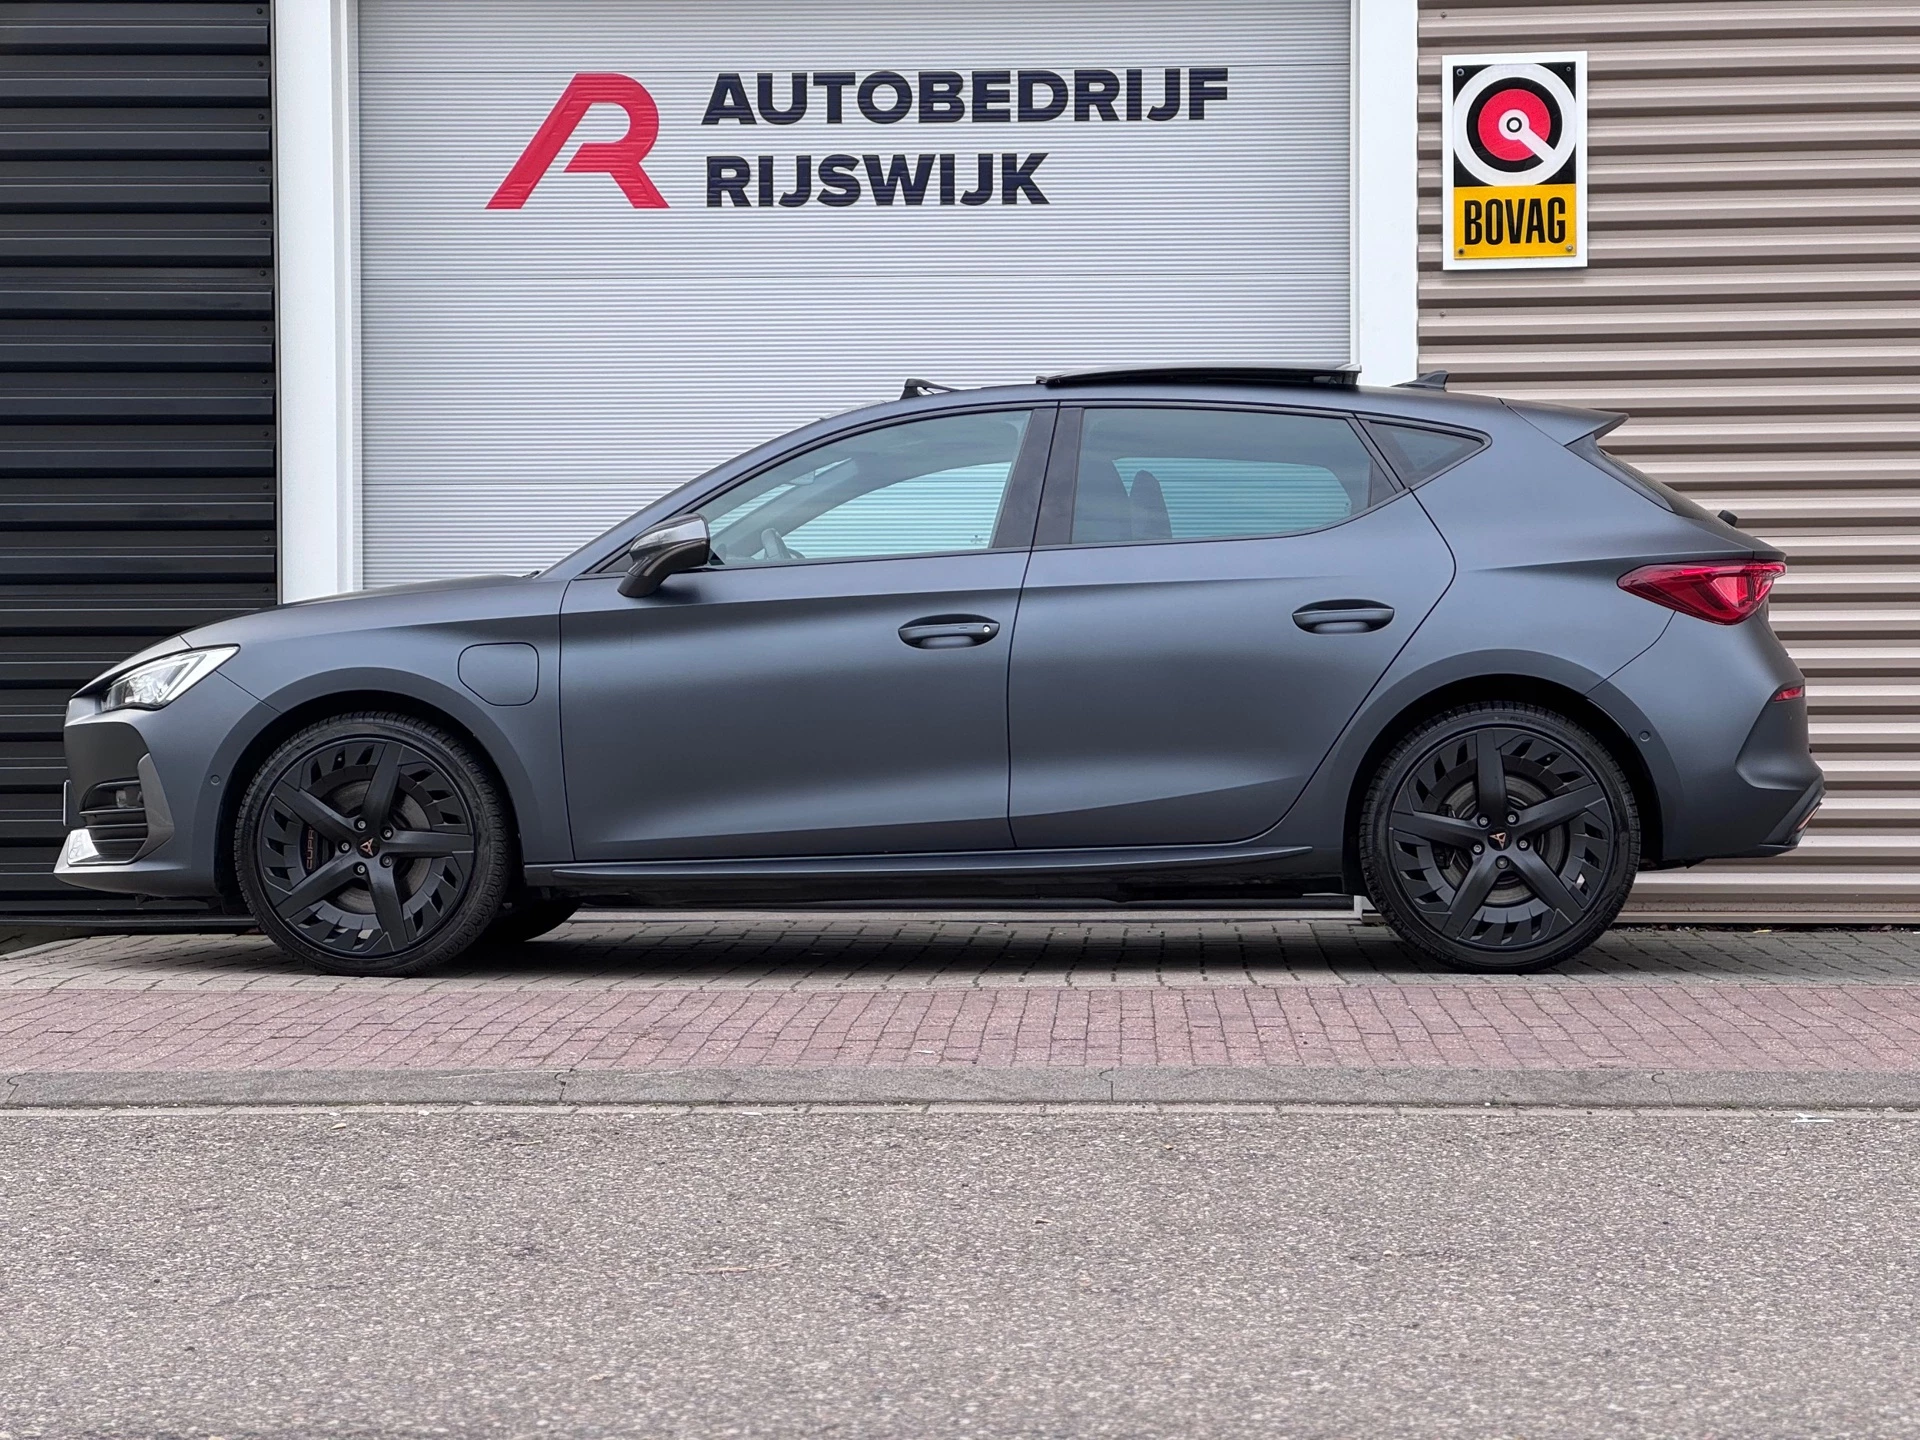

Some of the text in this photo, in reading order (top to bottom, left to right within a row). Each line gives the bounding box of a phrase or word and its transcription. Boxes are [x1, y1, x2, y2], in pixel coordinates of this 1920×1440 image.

[702, 68, 1228, 125] AUTOBEDRIJF
[707, 153, 1049, 207] RIJSWIJK
[1465, 197, 1565, 245] BOVAG
[306, 826, 314, 870] CUPR
